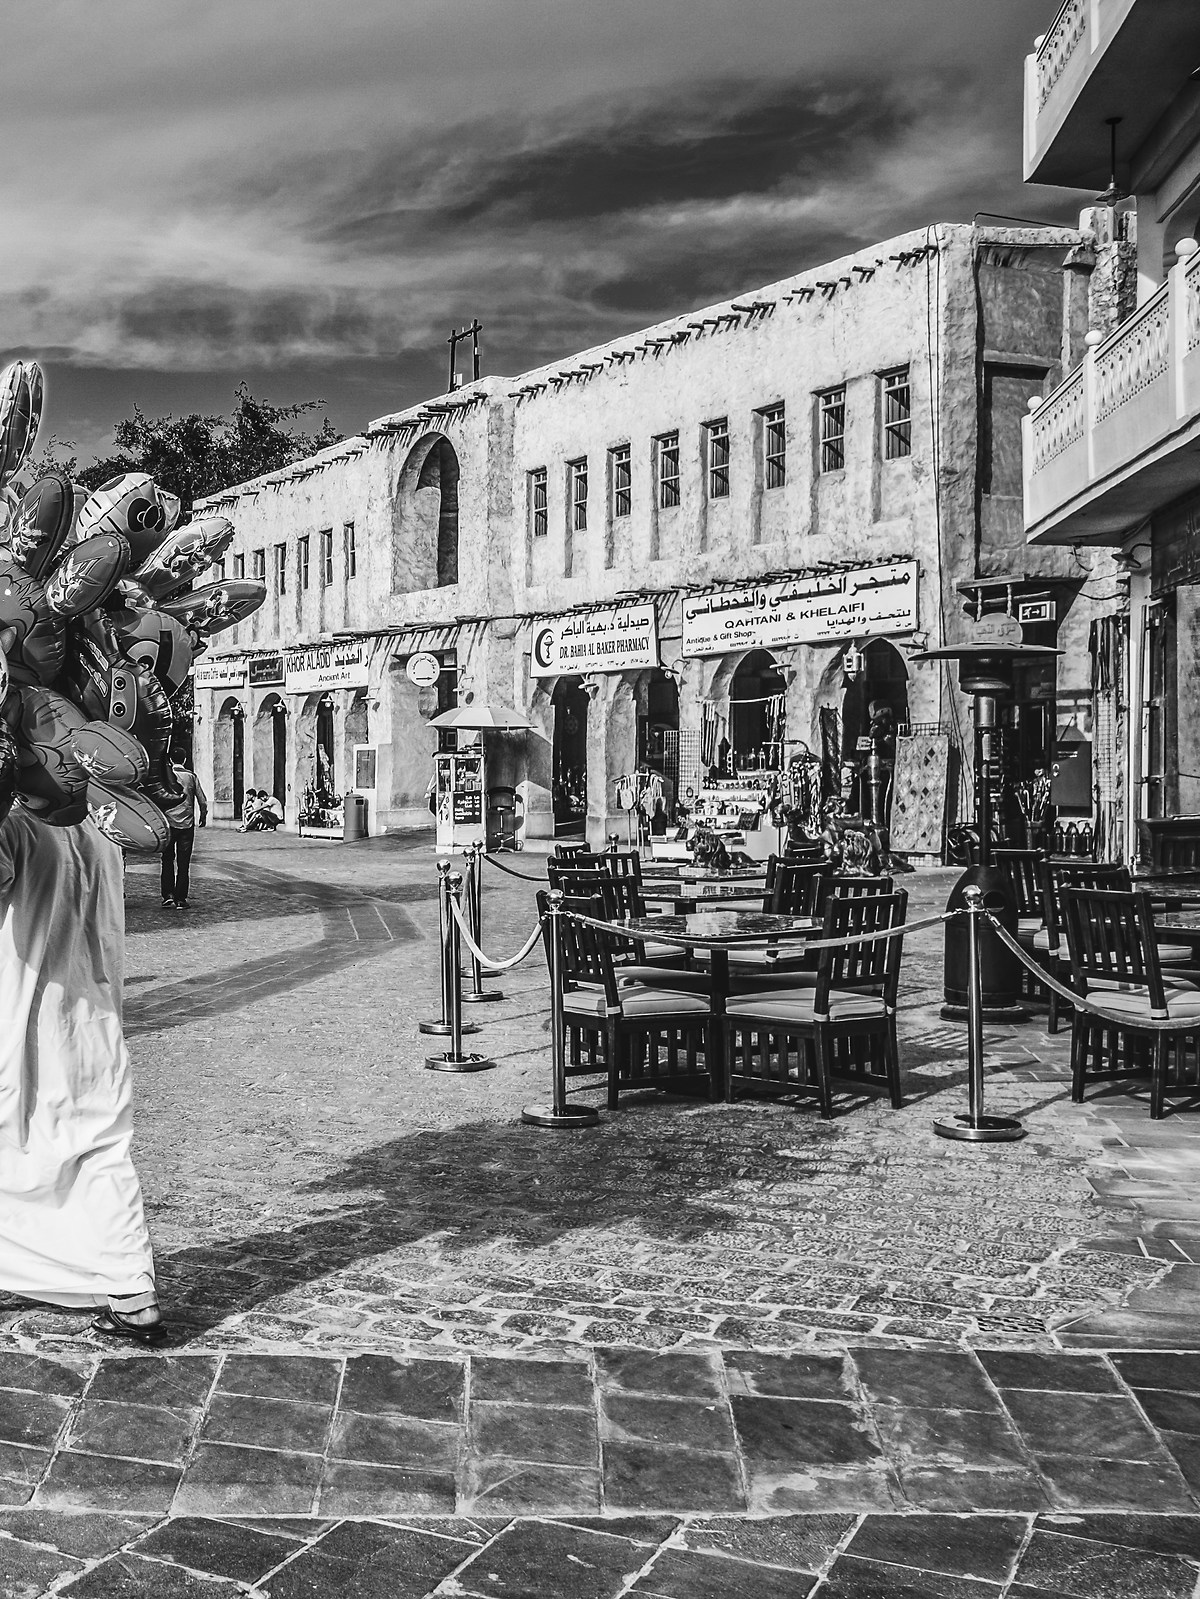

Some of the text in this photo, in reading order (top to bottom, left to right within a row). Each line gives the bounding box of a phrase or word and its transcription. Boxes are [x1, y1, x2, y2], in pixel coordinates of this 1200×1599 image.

[686, 568, 911, 624] متجر الخليفي والقحطاني
[617, 613, 649, 632] صيدلية
[724, 602, 864, 629] QAHTANI & KHELAIFI
[827, 608, 911, 629] للتحف والهدايا
[560, 620, 585, 640] الباكر
[686, 636, 711, 645] Antique
[720, 632, 732, 640] Gift
[734, 631, 753, 639] Shop
[559, 636, 650, 659] DR. BAHIA AL BAKER PHARMACY
[286, 654, 305, 673] KHOR
[341, 672, 351, 680] Art
